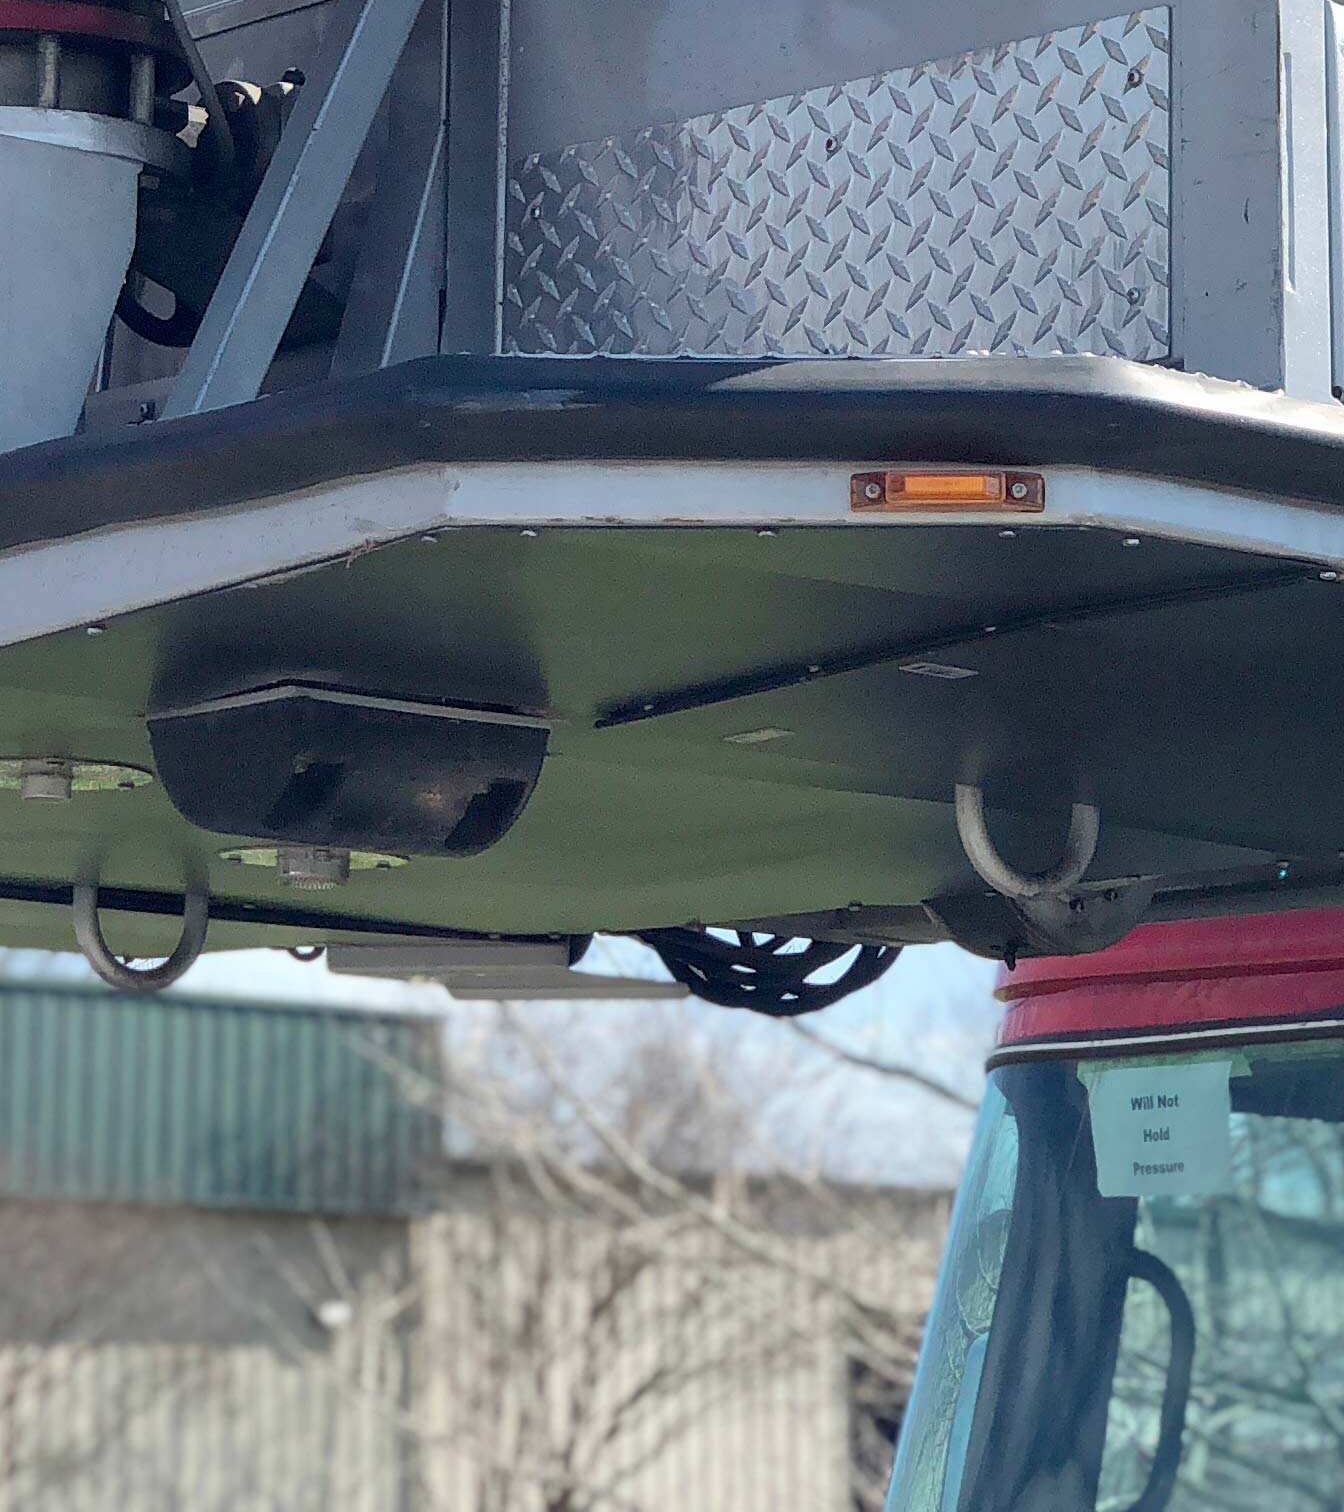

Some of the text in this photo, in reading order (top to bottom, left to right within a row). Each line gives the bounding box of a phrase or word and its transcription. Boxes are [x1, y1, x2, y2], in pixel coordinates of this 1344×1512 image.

[1131, 1094, 1179, 1110] Will Not
[1143, 1127, 1170, 1142] Hold
[1133, 1162, 1184, 1176] Pressure
